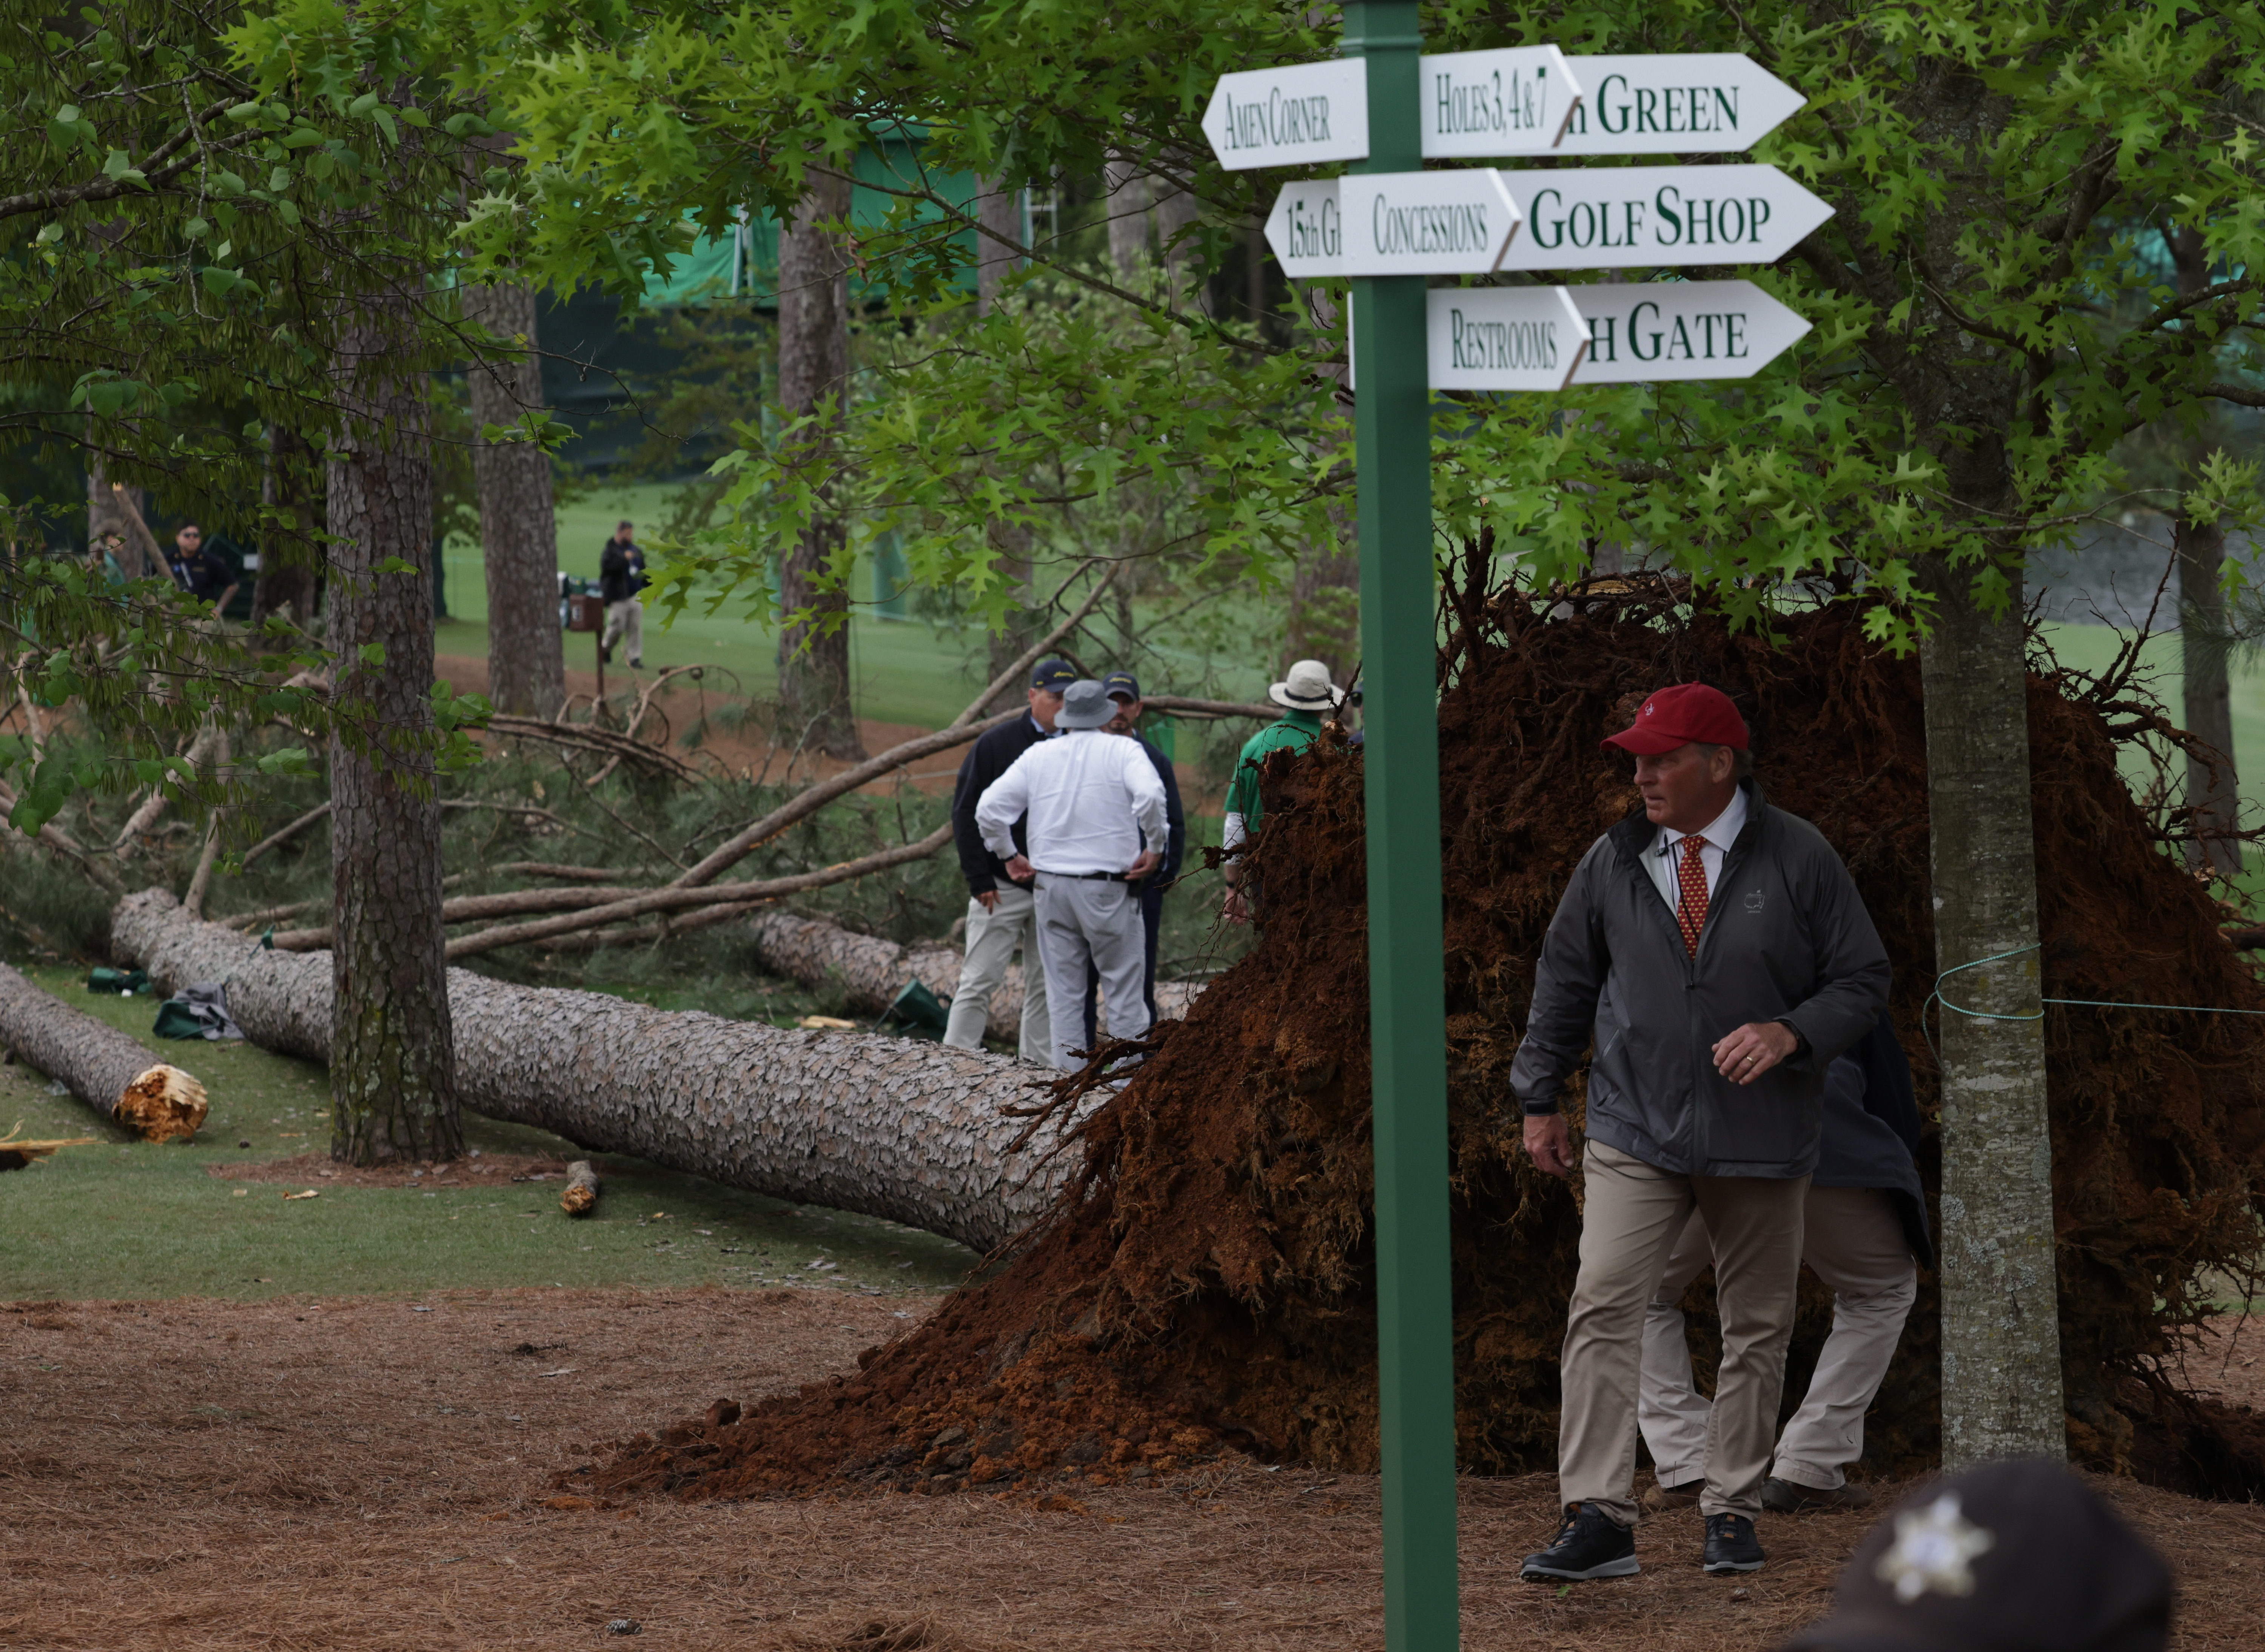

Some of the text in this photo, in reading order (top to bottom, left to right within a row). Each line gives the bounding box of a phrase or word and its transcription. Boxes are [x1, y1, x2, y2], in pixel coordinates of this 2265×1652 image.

[1224, 87, 1331, 149] AMEN CORNER
[1437, 65, 1547, 137] HOLES 3, 4 & 7
[1597, 74, 1739, 134] GREEN
[1288, 199, 1319, 258] 15th
[1373, 193, 1488, 254] CONCESSIONS
[1530, 185, 1771, 250] GOLF SHOP
[1450, 308, 1557, 371] RESTROOMS
[1627, 301, 1749, 361] GATE
